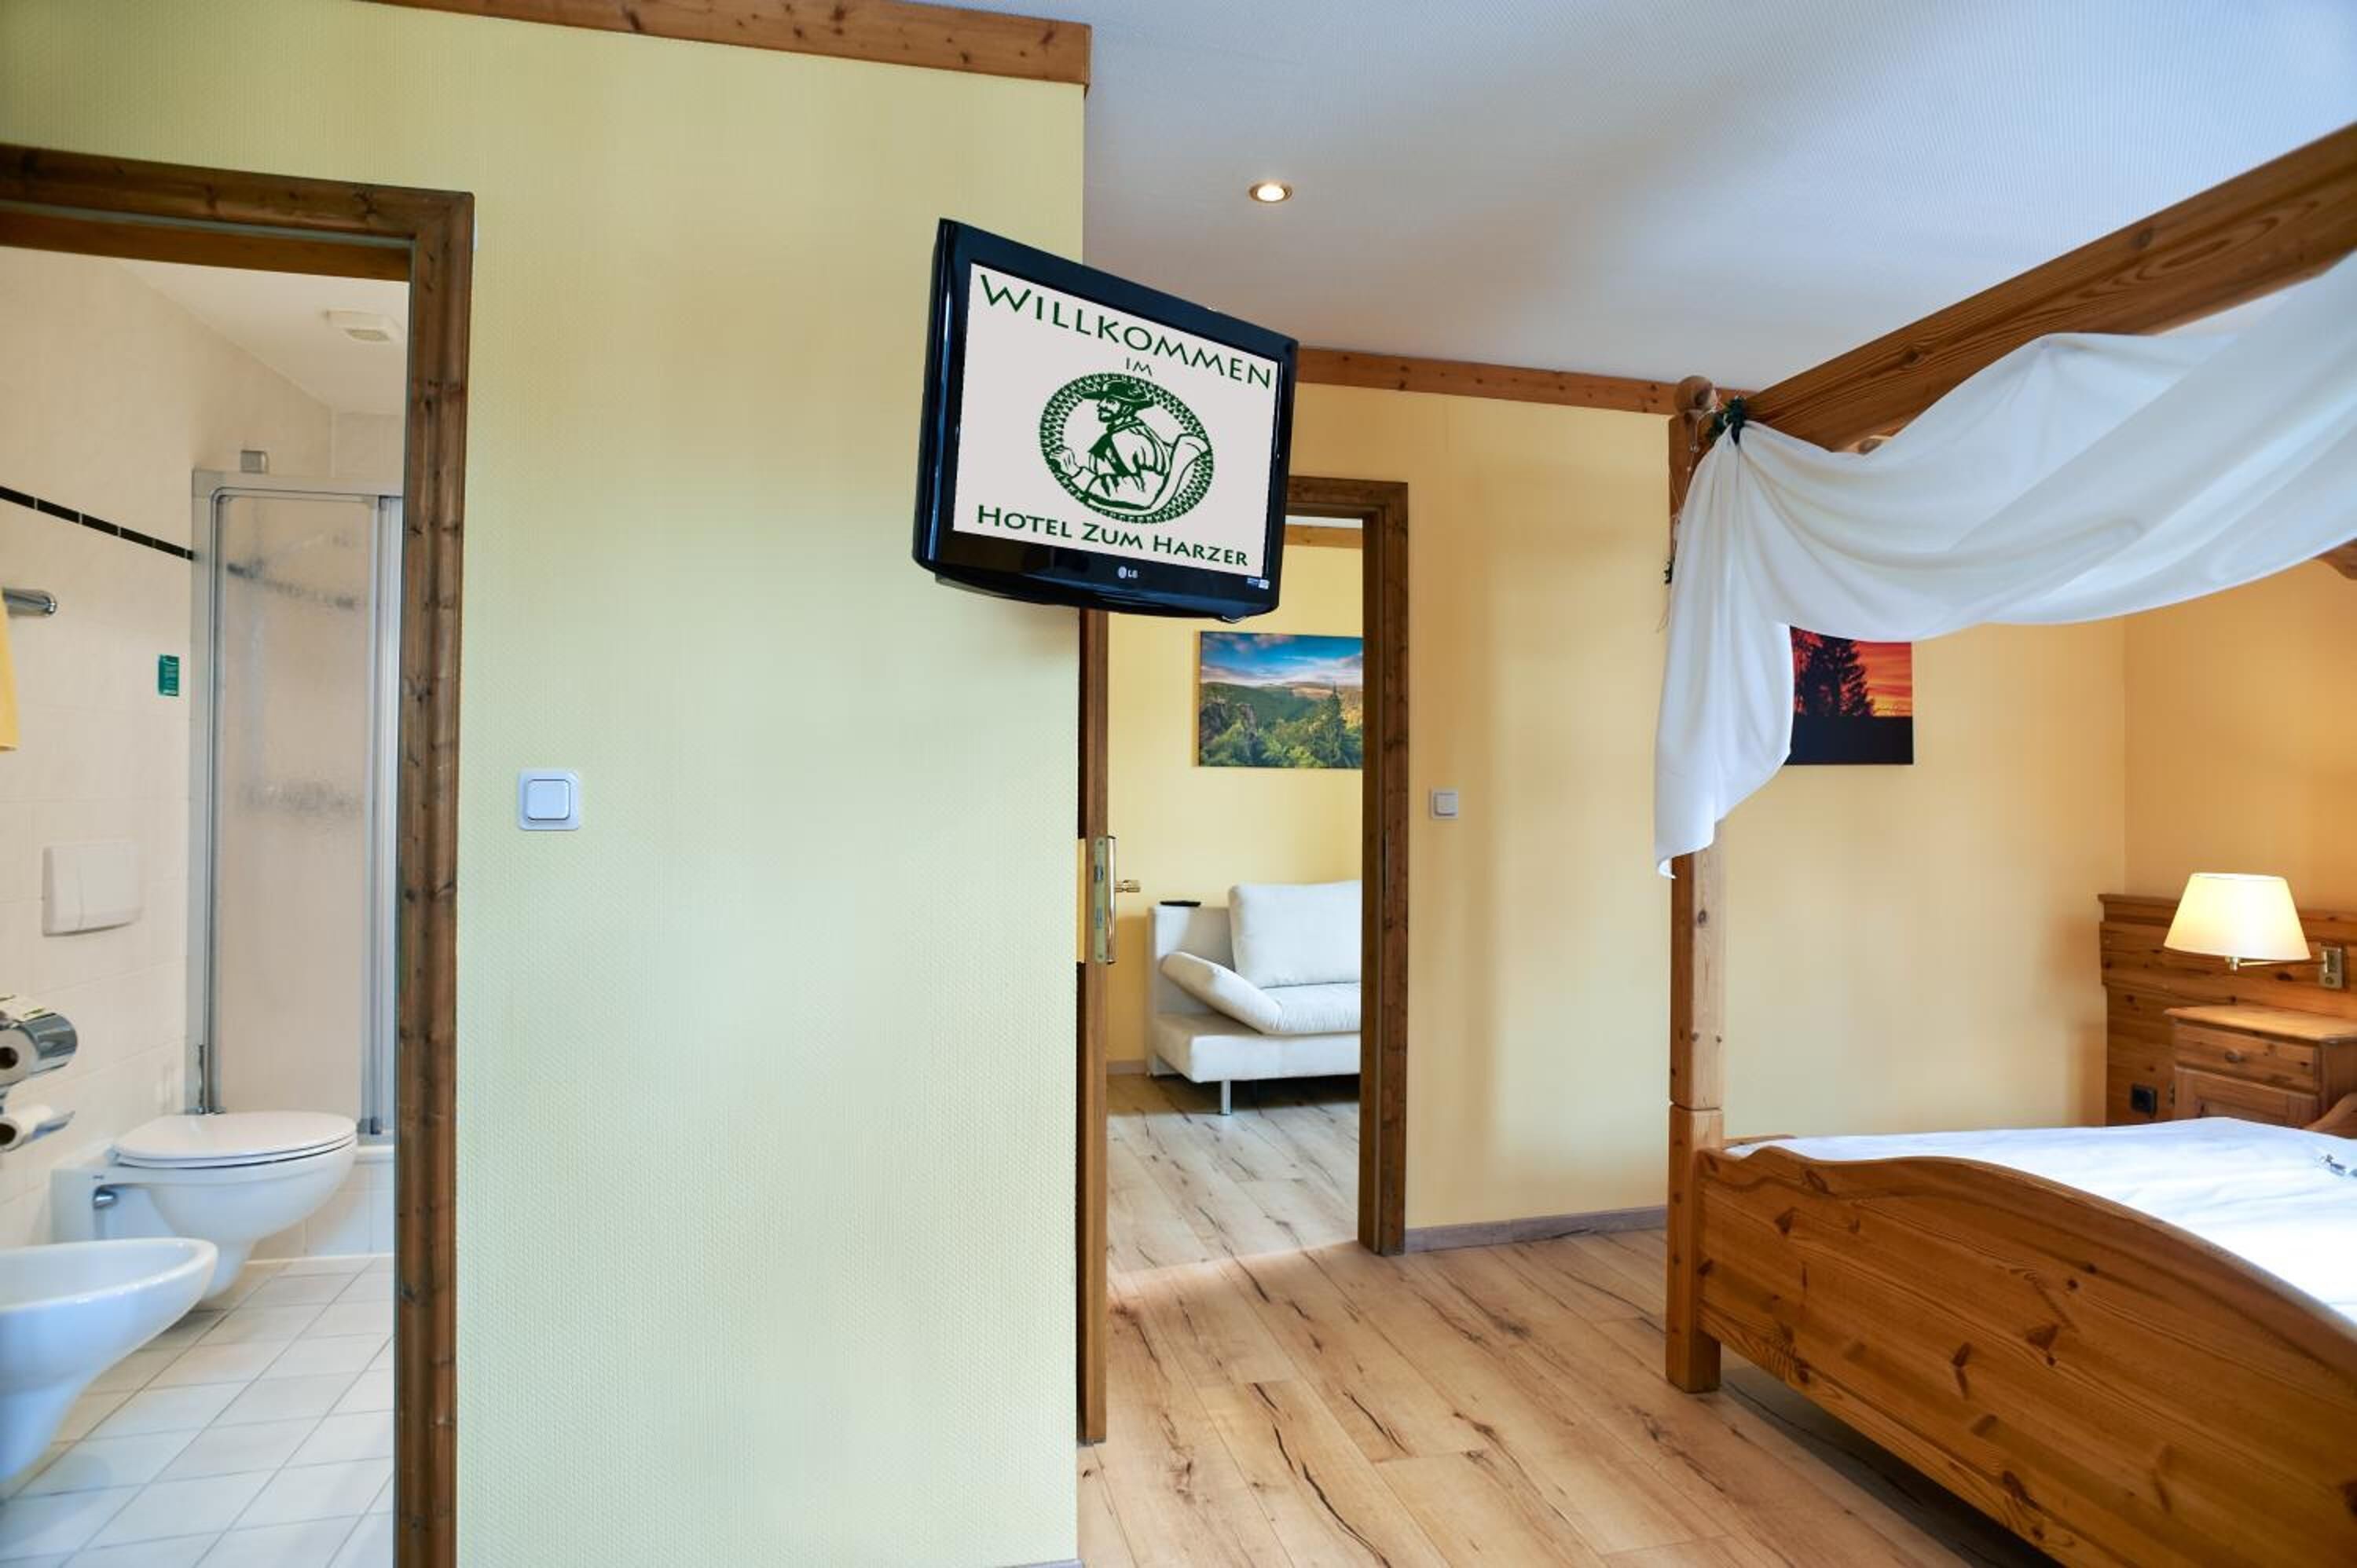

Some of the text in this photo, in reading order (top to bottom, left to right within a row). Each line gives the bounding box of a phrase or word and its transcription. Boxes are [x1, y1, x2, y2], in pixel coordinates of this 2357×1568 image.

[979, 273, 1271, 390] WILLKOMMEN
[1126, 357, 1153, 376] IM
[977, 504, 1249, 566] HOTEL ZUM HARZER
[1127, 569, 1138, 579] LG
